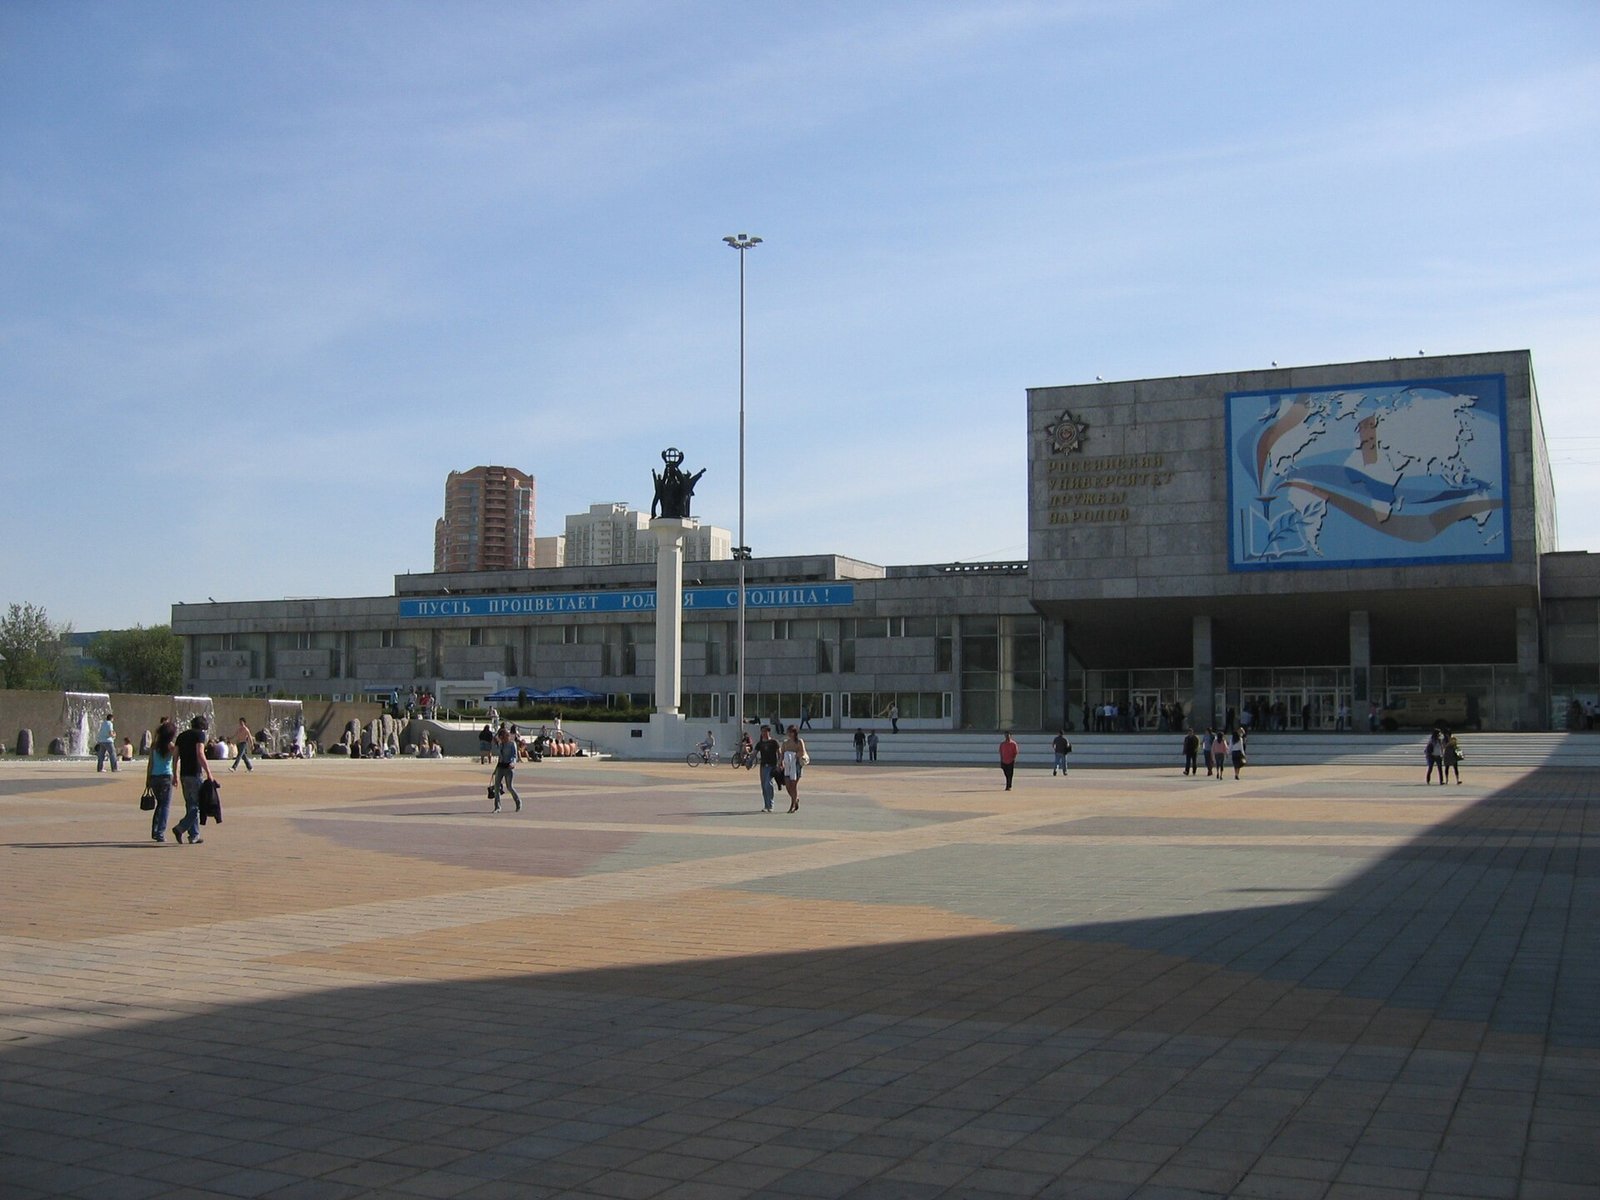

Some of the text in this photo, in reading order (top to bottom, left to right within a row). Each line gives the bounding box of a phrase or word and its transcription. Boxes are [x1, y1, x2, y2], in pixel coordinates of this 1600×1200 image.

[418, 602, 471, 615] ПУСТЬ
[489, 596, 599, 613] ПРОЦВЕТАЕТ
[622, 593, 695, 609] РОДЯ
